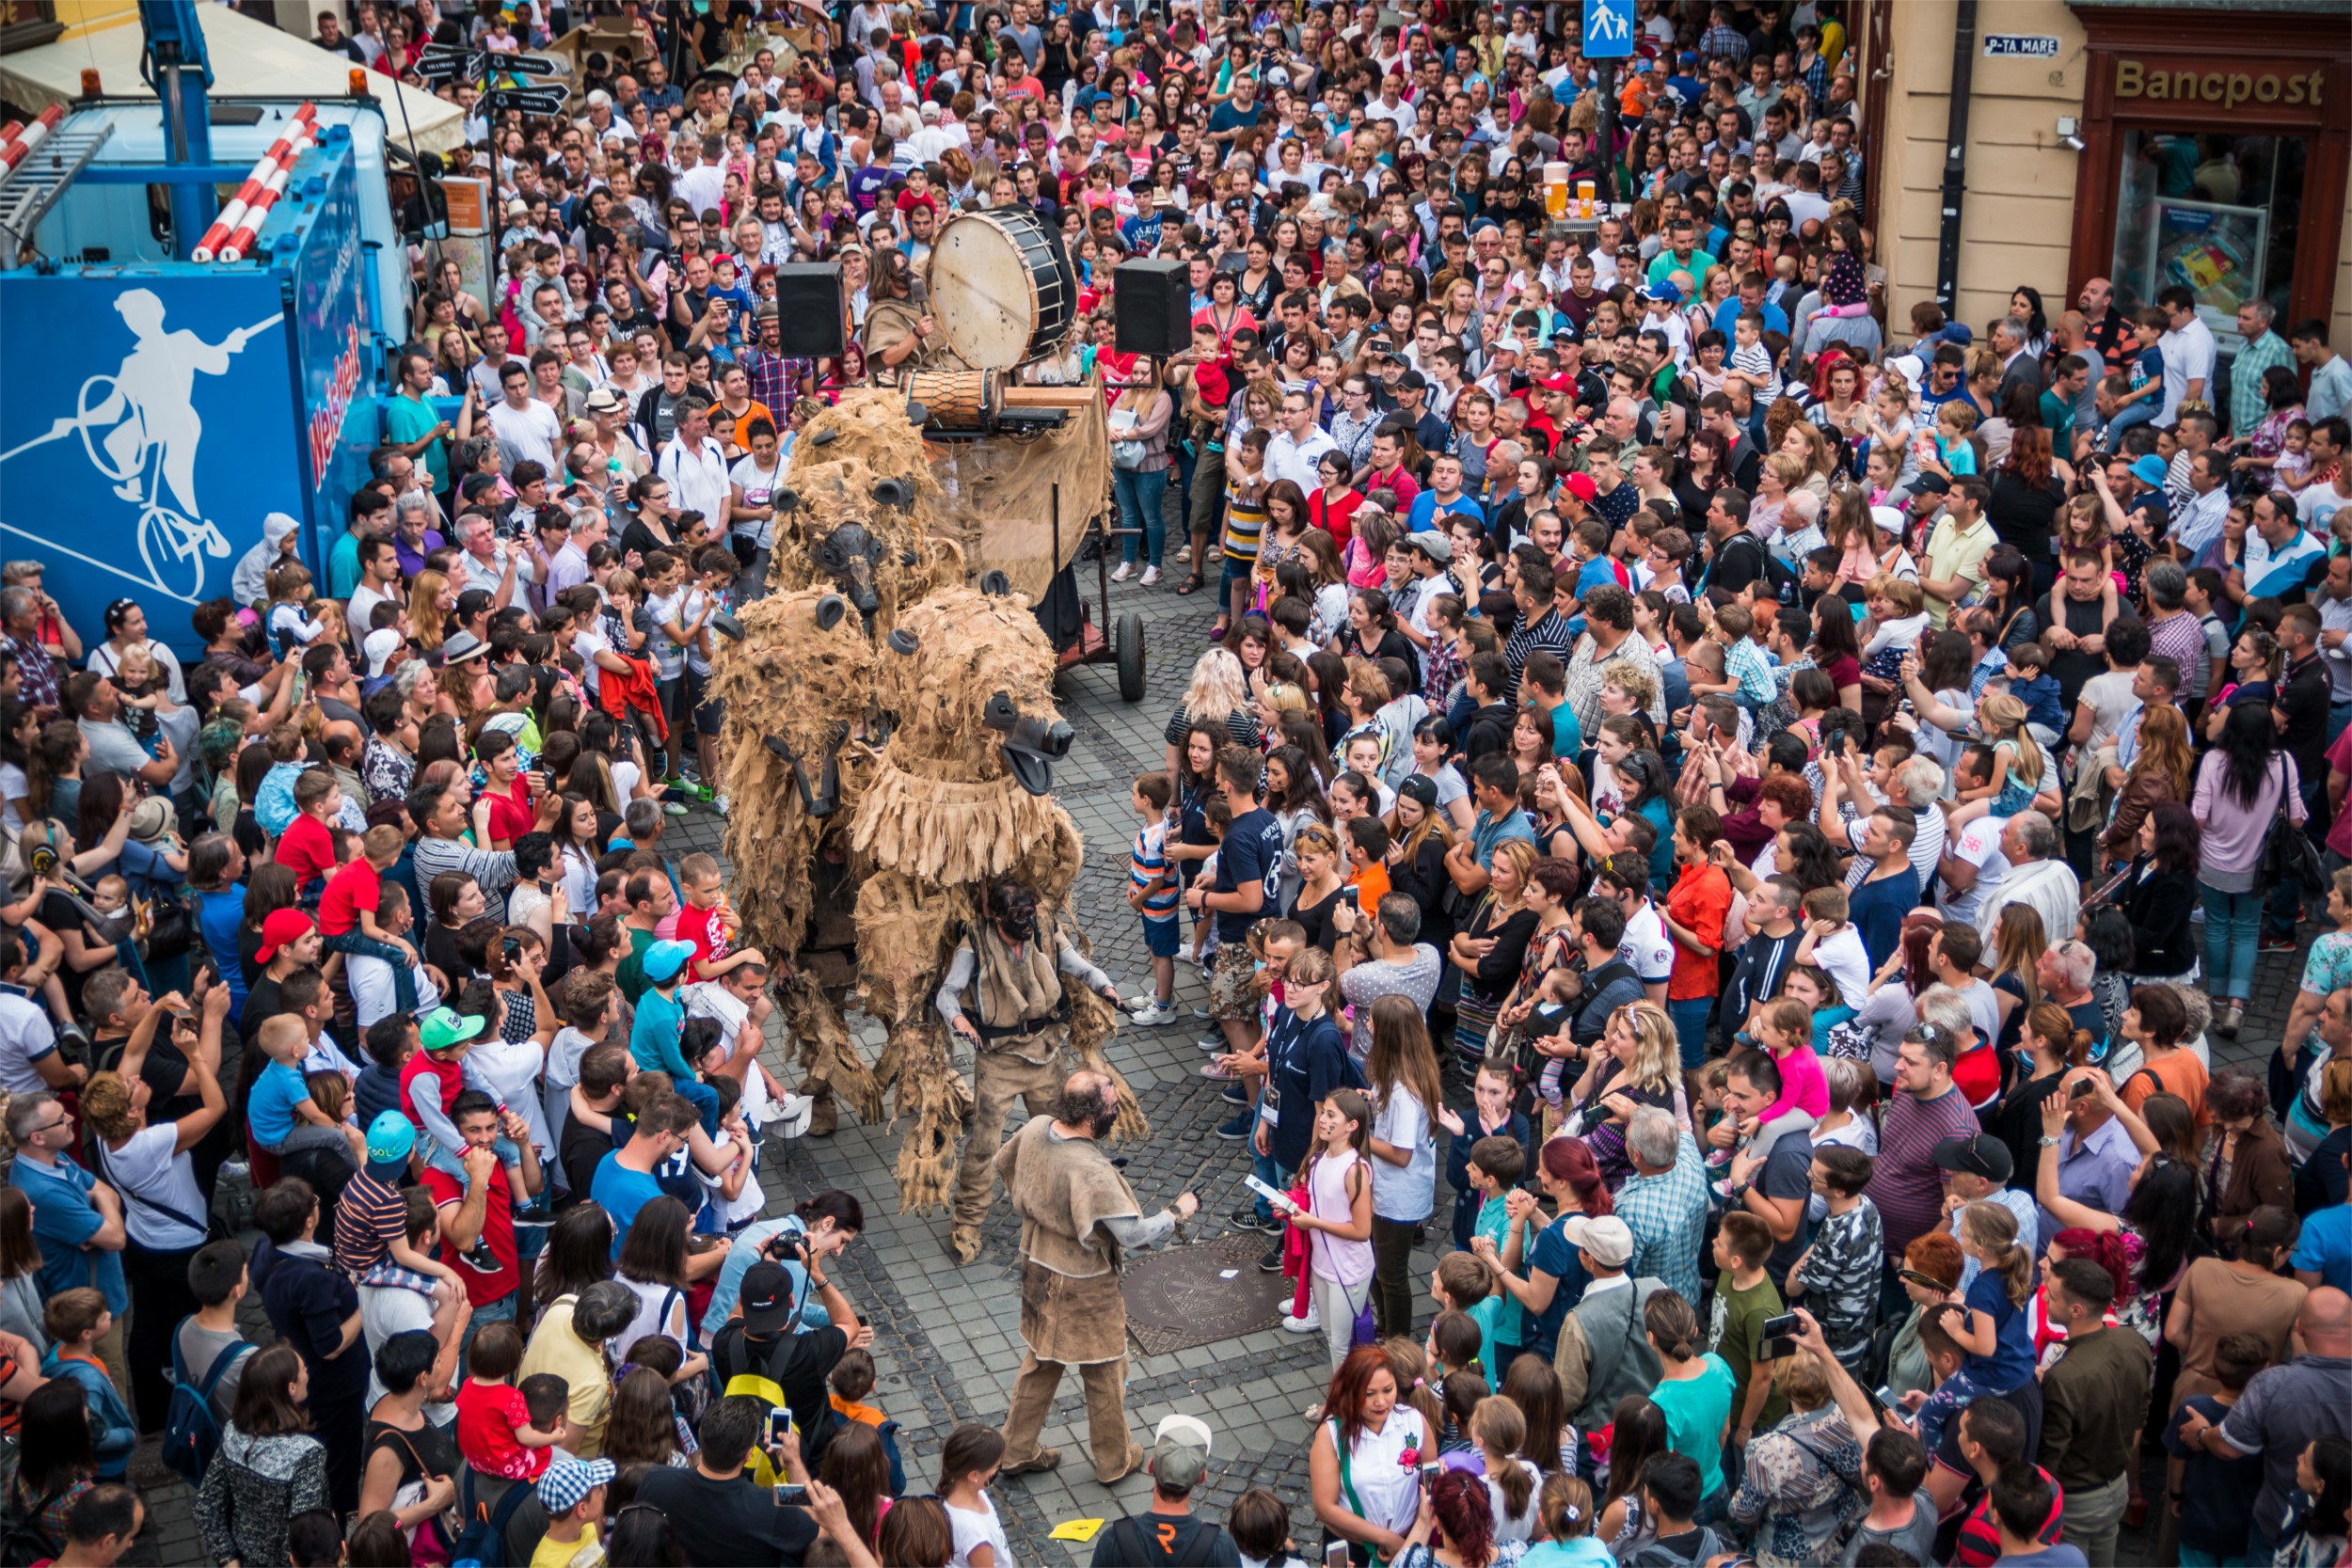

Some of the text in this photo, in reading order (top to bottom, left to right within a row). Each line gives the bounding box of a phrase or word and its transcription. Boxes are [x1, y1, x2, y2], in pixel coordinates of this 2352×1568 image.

[1989, 39, 2055, 54] P-TA MARE
[2115, 59, 2325, 109] Bancpost
[308, 314, 361, 495] Weisheit
[1963, 834, 1982, 852] 56
